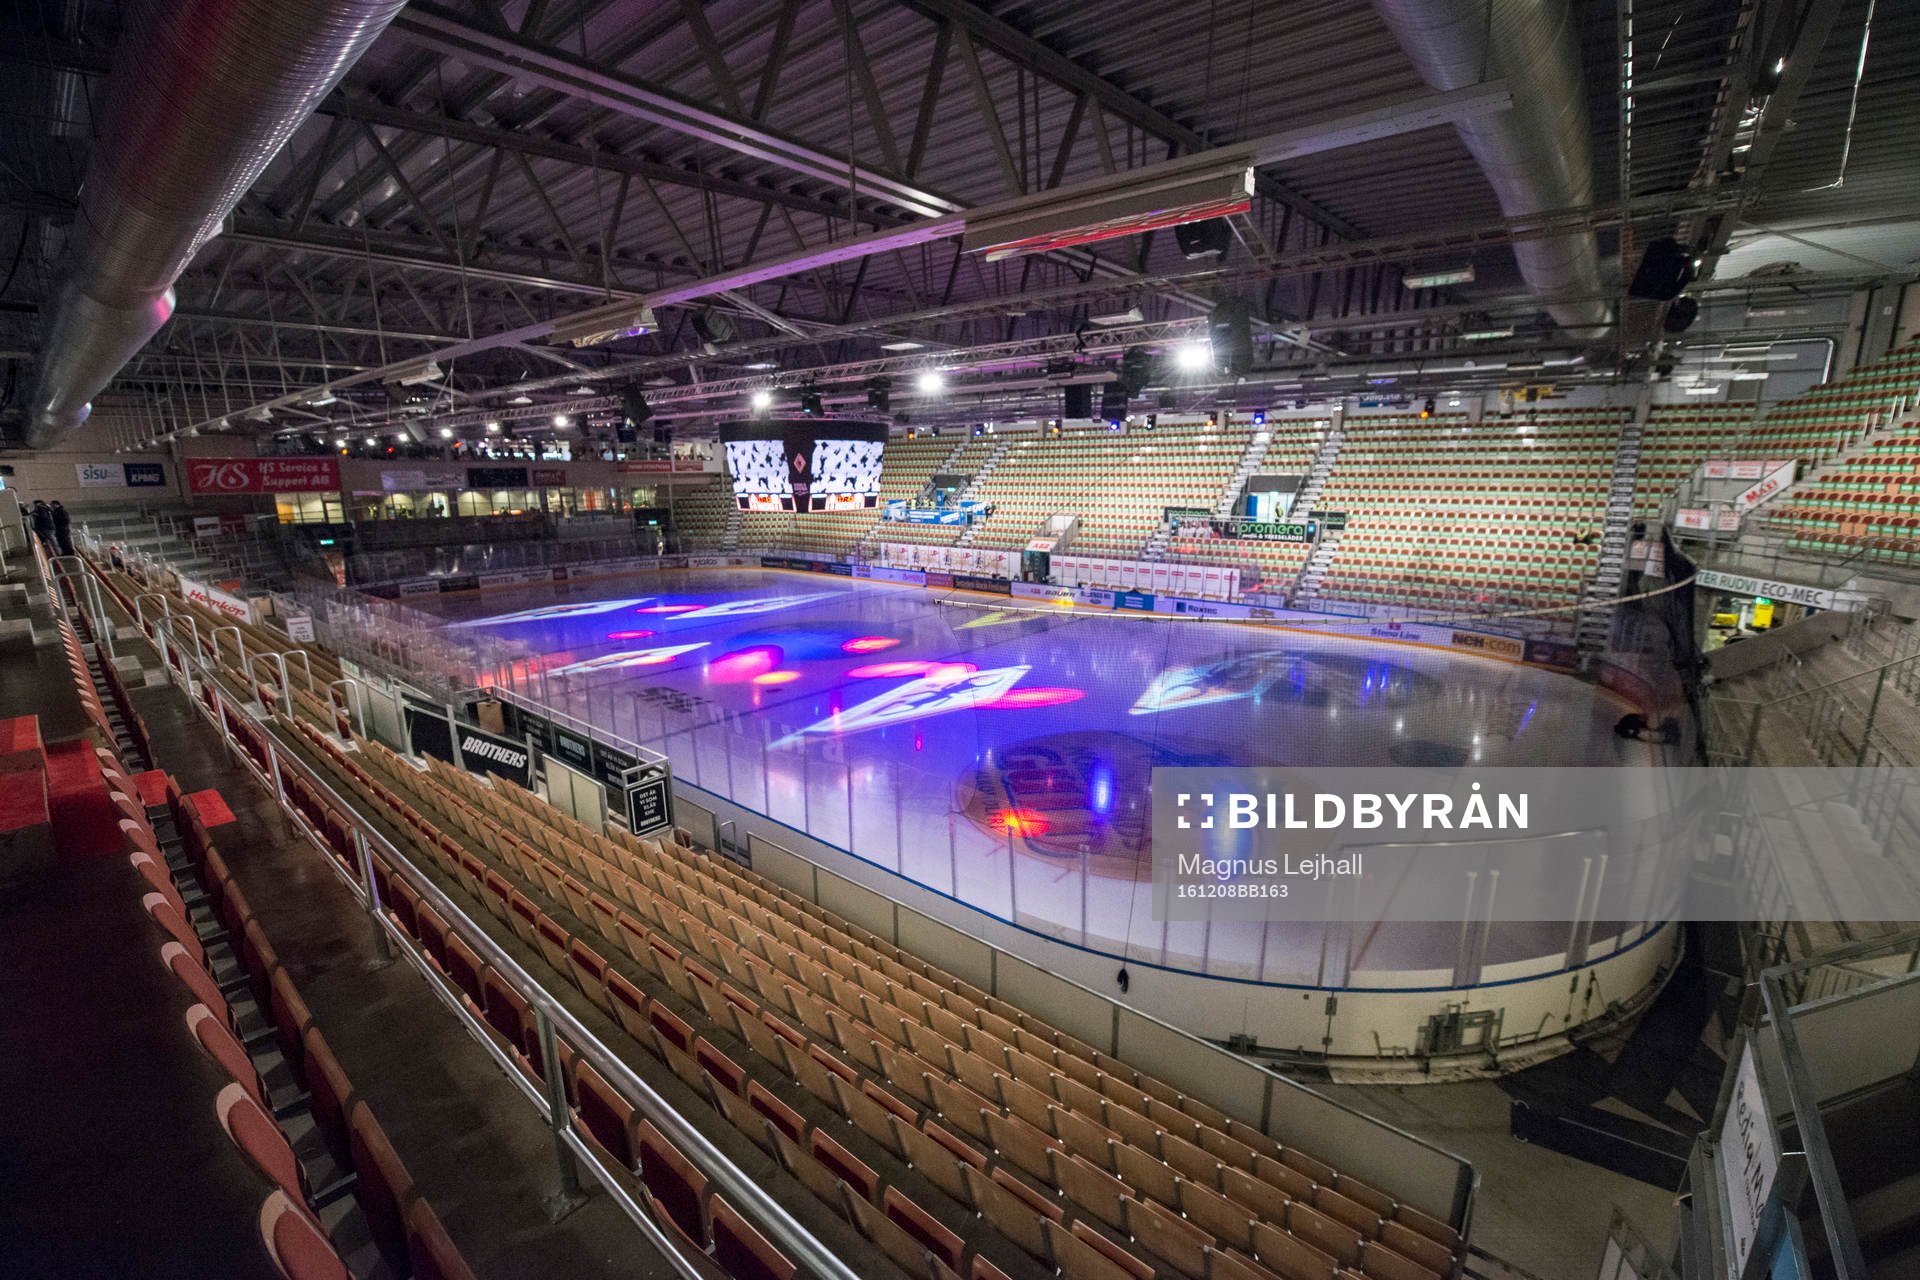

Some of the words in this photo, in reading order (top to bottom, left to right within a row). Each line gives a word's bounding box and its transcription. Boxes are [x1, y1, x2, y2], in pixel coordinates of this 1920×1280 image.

[279, 462, 318, 473] Service
[321, 462, 330, 473] &
[131, 473, 160, 483] KPMG
[263, 475, 308, 488] Support
[311, 475, 330, 486] AB
[1240, 523, 1304, 536] promera
[1720, 576, 1757, 593] RUDVI
[1760, 582, 1823, 605] ECO-MEC
[1188, 604, 1218, 615] Roxtec
[460, 735, 528, 769] BROTHERS
